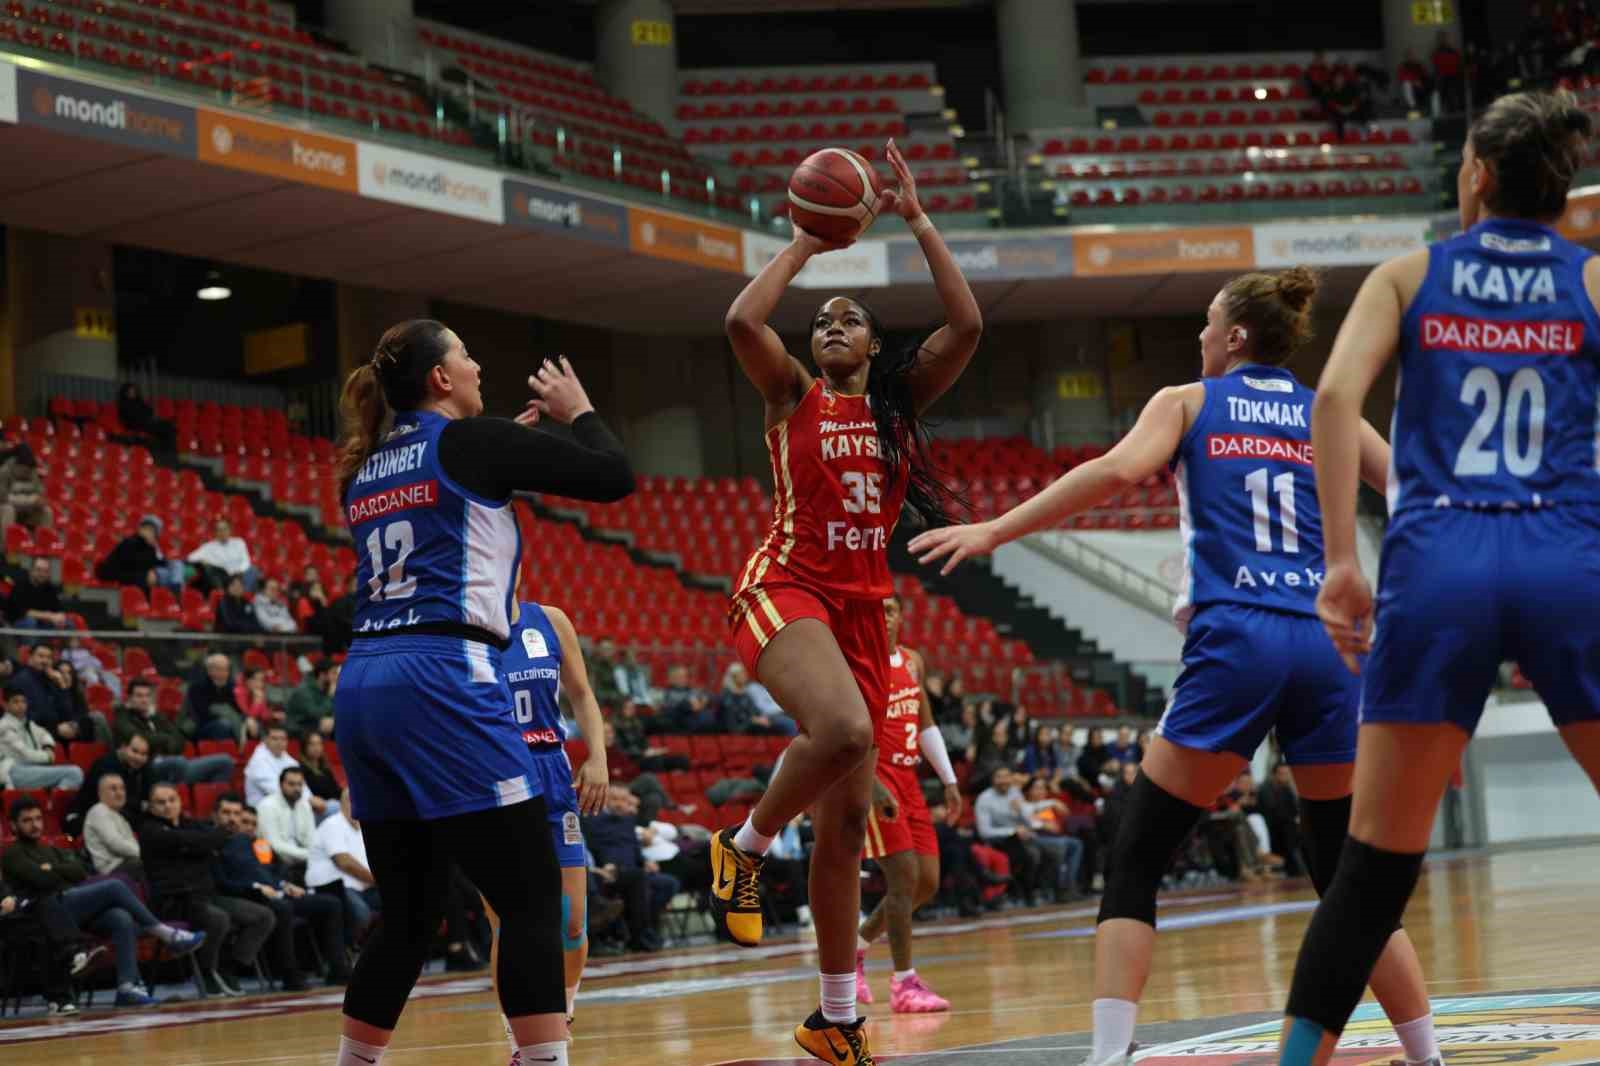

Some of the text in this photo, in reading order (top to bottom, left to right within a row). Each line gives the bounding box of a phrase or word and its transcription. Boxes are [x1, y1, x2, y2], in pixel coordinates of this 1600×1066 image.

[1451, 260, 1557, 303] KAYA
[1423, 319, 1576, 350] DARDANEL
[1226, 396, 1307, 428] TOKMAK
[1453, 366, 1546, 478] 20
[355, 440, 428, 485] ALTUNBEY
[349, 484, 434, 523] DARDANEL
[840, 471, 883, 514] 35
[1244, 467, 1300, 553] 11
[366, 520, 418, 602] 12
[904, 722, 918, 750] 2
